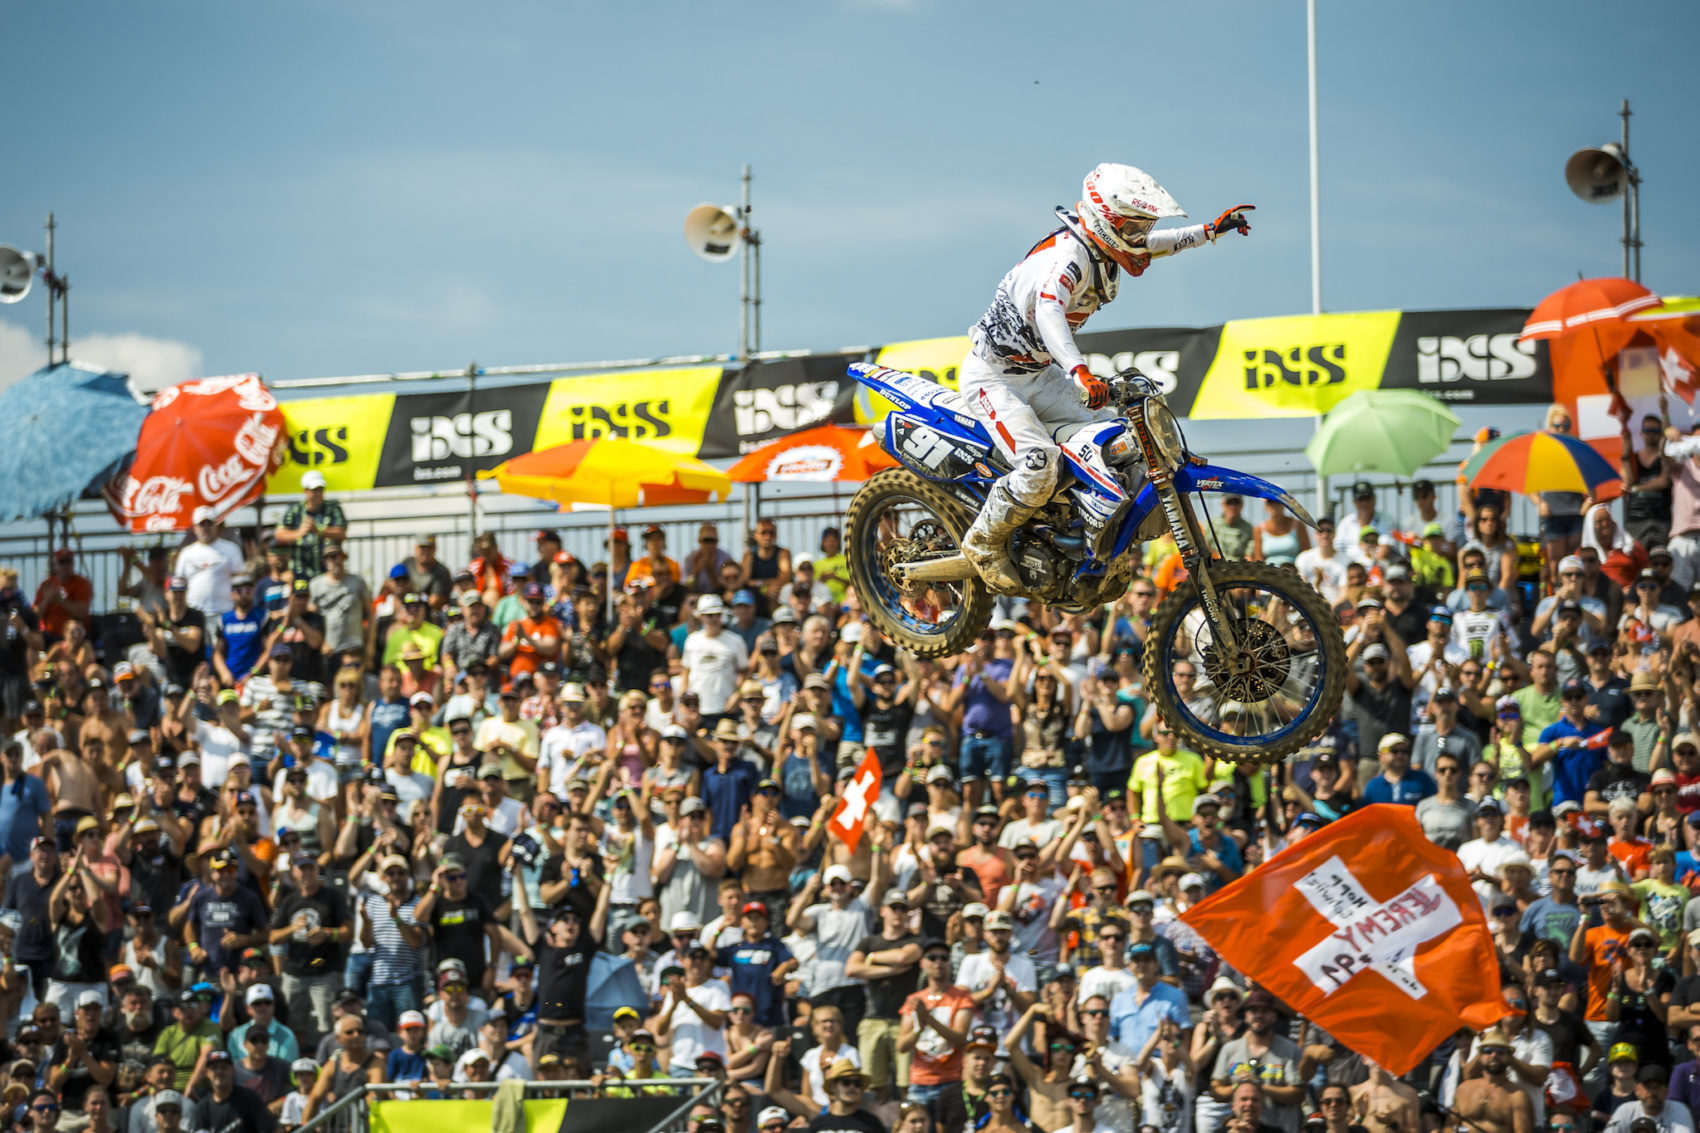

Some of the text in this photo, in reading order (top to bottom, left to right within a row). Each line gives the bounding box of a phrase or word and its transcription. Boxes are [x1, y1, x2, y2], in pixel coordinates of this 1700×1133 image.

[1094, 220, 1120, 249] TRICORP
[880, 389, 912, 411] DUNLOP
[954, 414, 977, 429] YAMAHA
[903, 426, 956, 471] 91
[1196, 479, 1224, 489] VERTEX
[1077, 505, 1105, 530] TRICORP
[1161, 495, 1191, 550] YAMAHA
[1201, 588, 1219, 623] TRICORP
